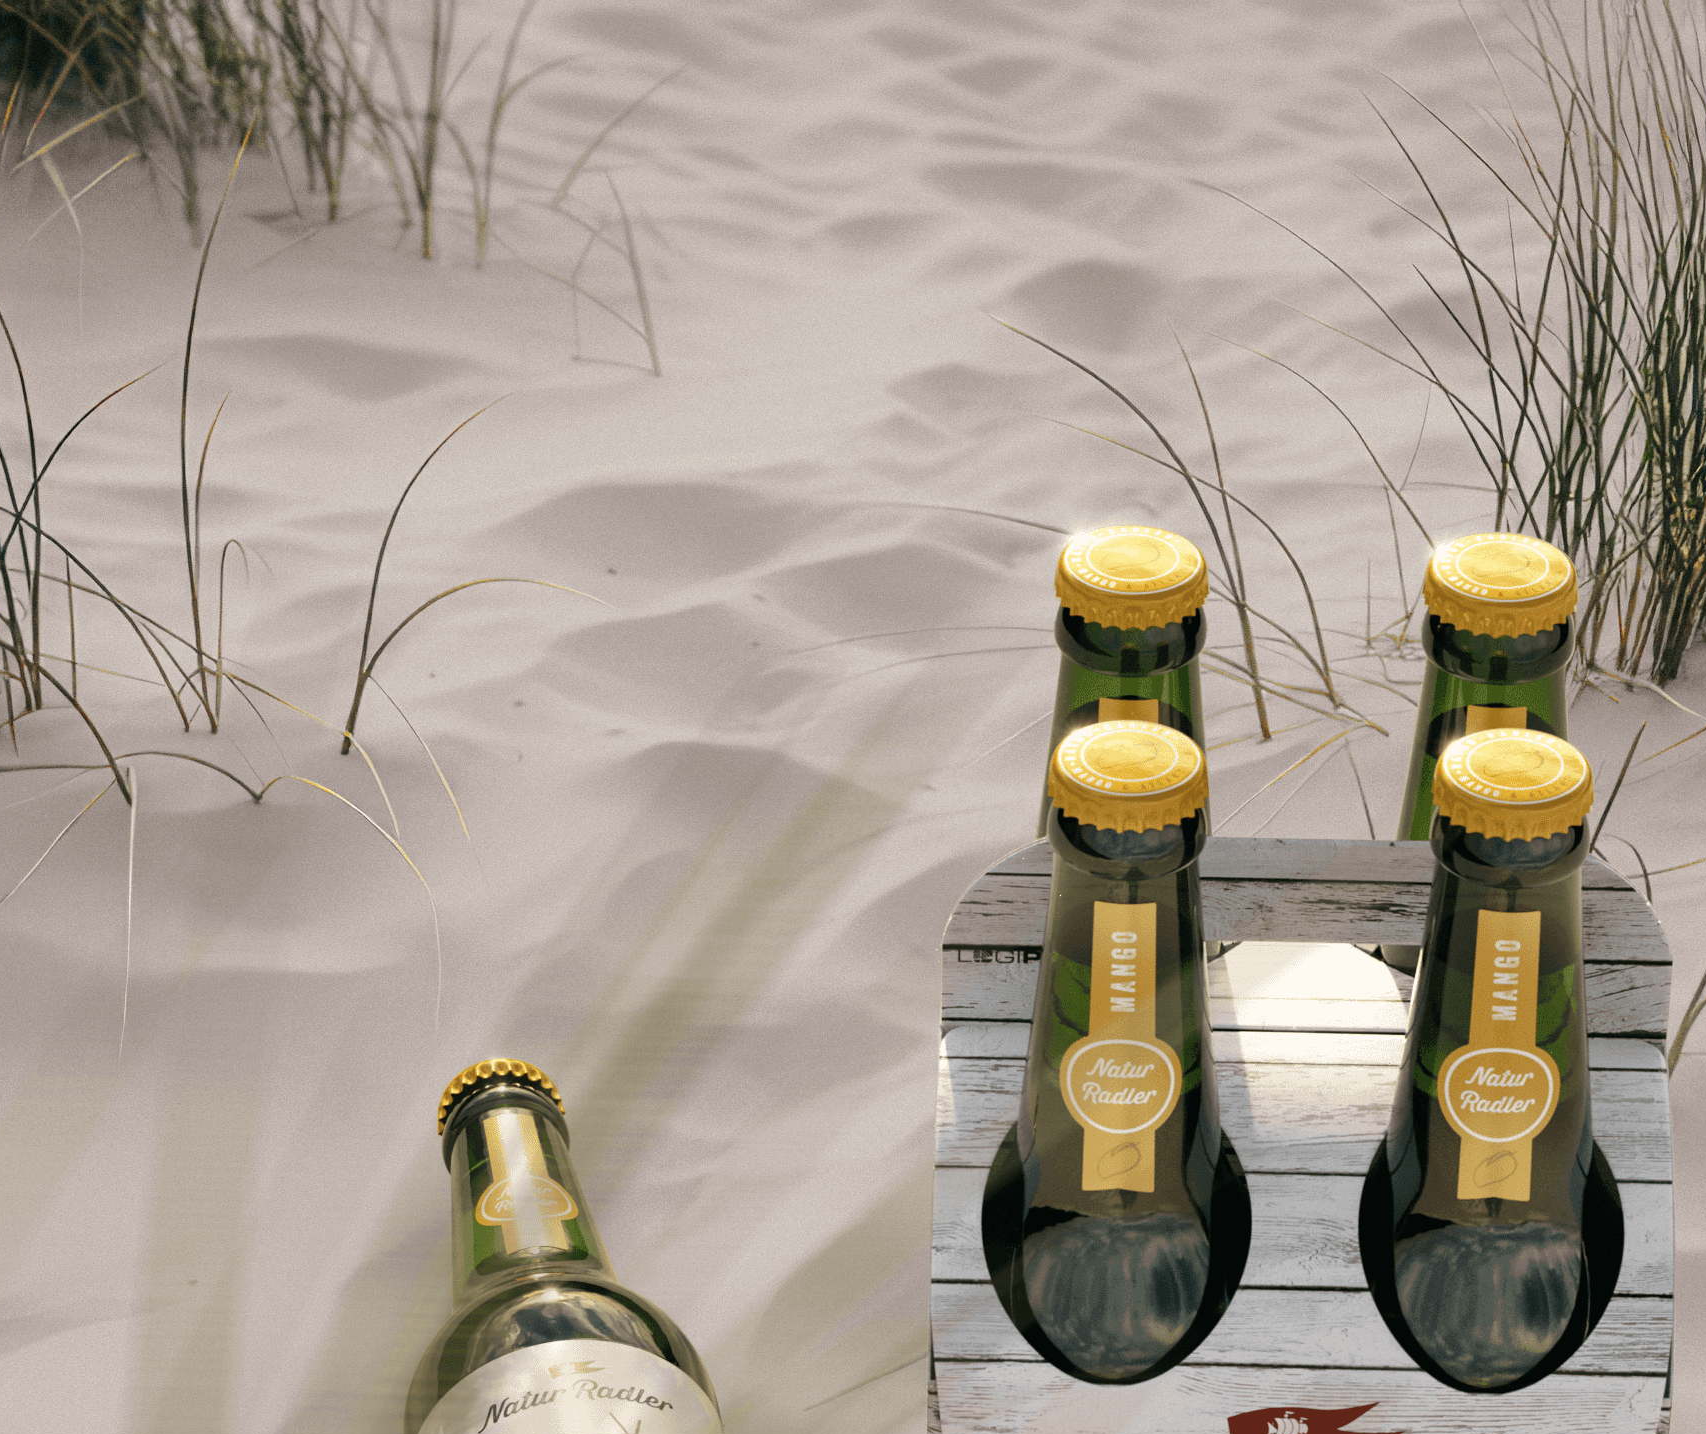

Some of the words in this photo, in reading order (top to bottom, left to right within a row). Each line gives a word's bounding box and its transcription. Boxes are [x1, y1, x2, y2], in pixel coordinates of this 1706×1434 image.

[1109, 931, 1138, 1013] MANGO
[1491, 939, 1522, 1021] MANGO
[1086, 1057, 1155, 1079] Natur
[1464, 1066, 1535, 1088] Natur
[1082, 1081, 1158, 1106] Radler
[1460, 1090, 1536, 1114] Radler
[477, 1388, 567, 1434] Natur
[571, 1379, 674, 1412] Radler
